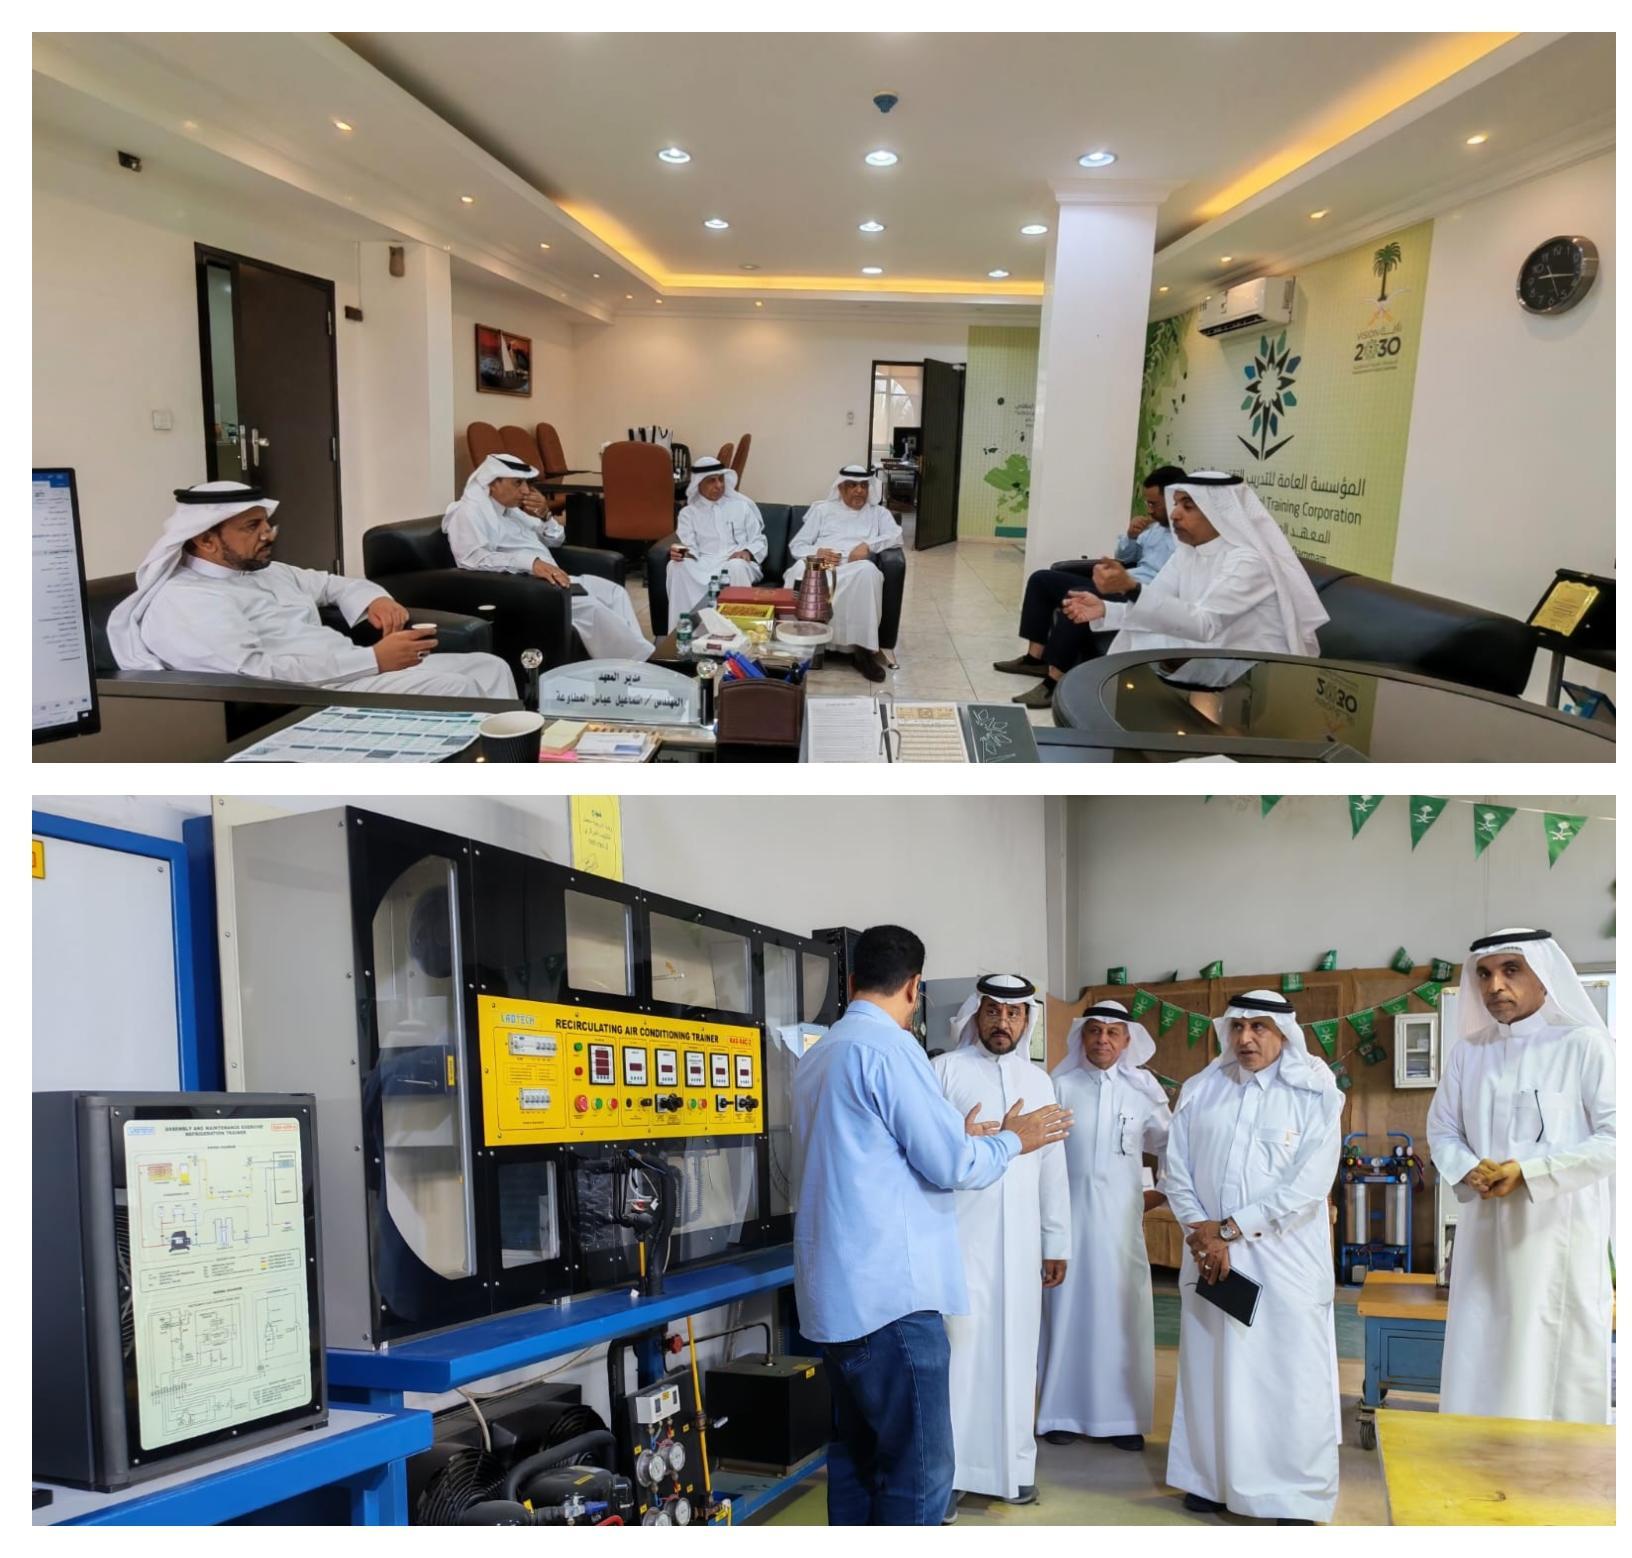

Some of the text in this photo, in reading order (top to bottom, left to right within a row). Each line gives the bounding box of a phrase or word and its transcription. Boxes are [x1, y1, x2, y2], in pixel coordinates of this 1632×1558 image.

[1246, 472, 1276, 489] للتدريب
[1277, 473, 1308, 490] العامة
[1311, 477, 1367, 499] المؤسسة
[1267, 496, 1300, 518] Training
[1302, 501, 1362, 525] Corporation
[598, 671, 641, 686] مدير المعهد
[501, 1013, 535, 1025] LABTECH
[555, 1018, 719, 1044] RECIRCULATING AIR CONDITIONING TRAINER
